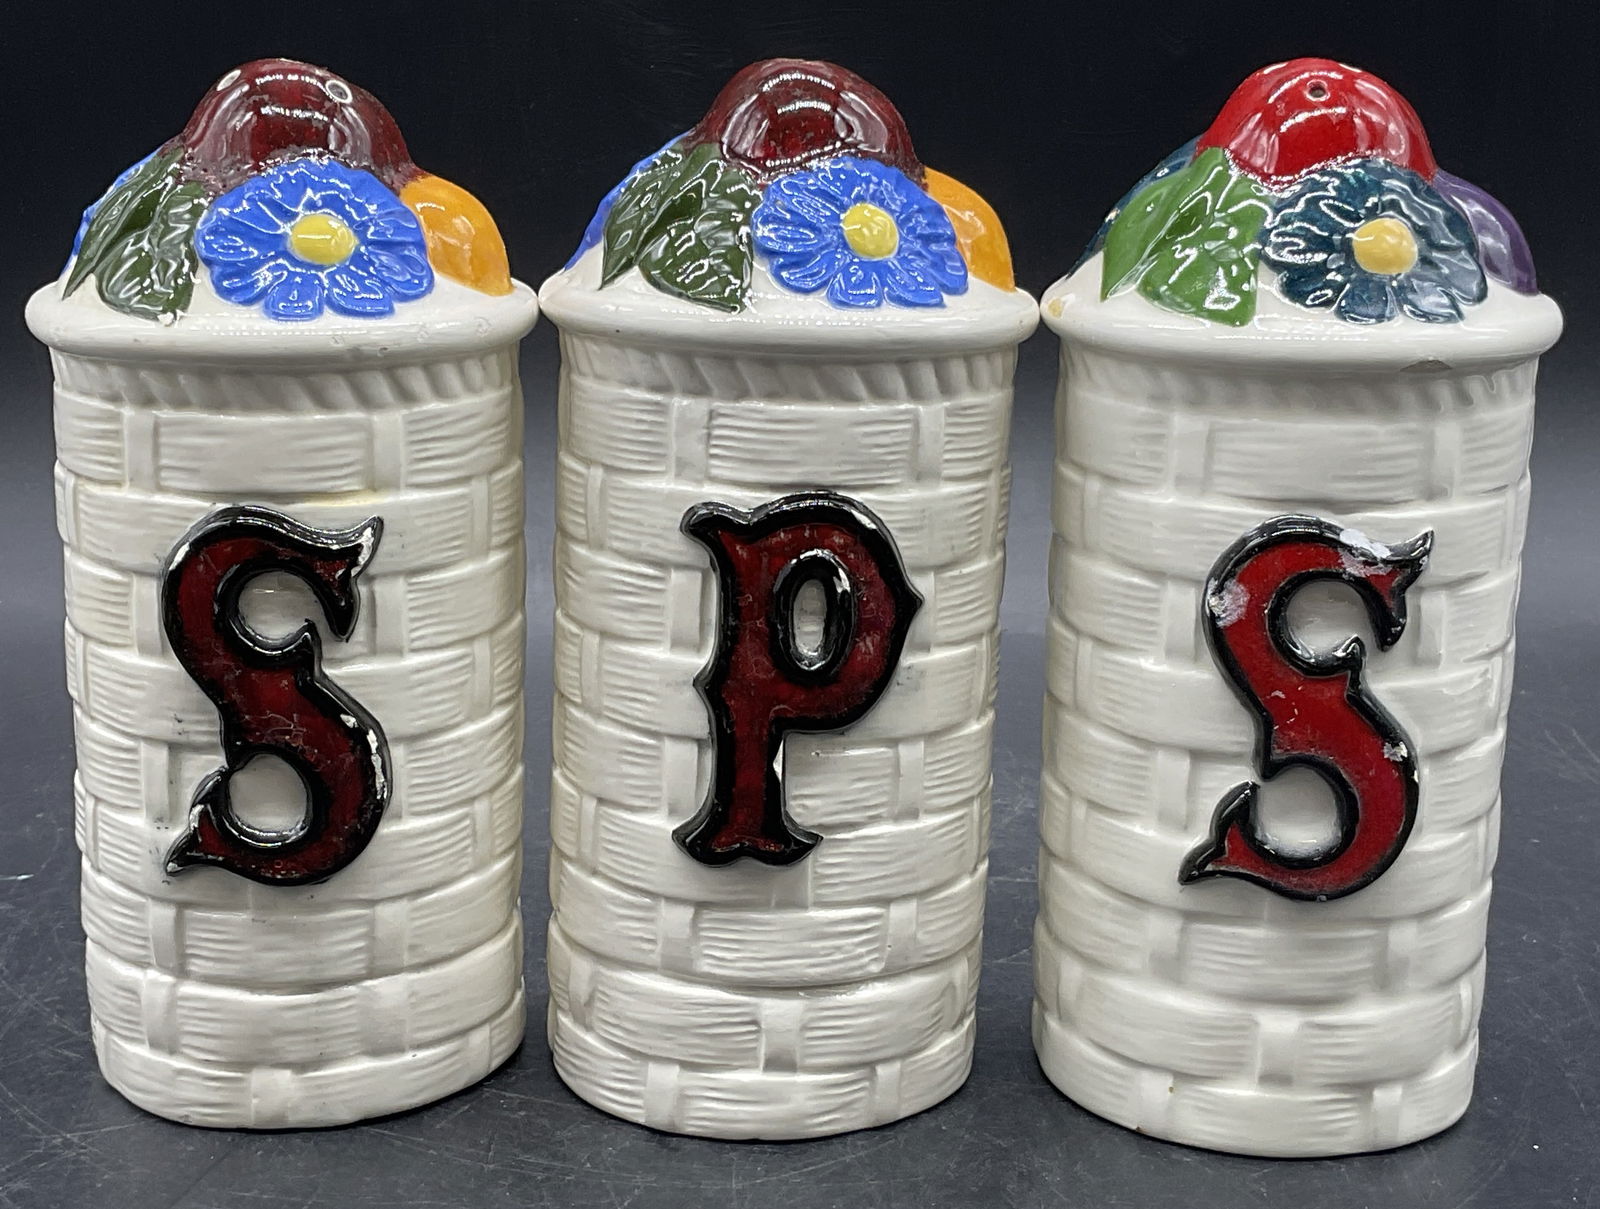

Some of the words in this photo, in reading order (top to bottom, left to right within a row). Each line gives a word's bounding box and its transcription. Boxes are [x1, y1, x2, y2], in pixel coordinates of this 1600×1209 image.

[162, 504, 392, 887] S
[671, 490, 924, 866] P
[1179, 515, 1434, 902] S
